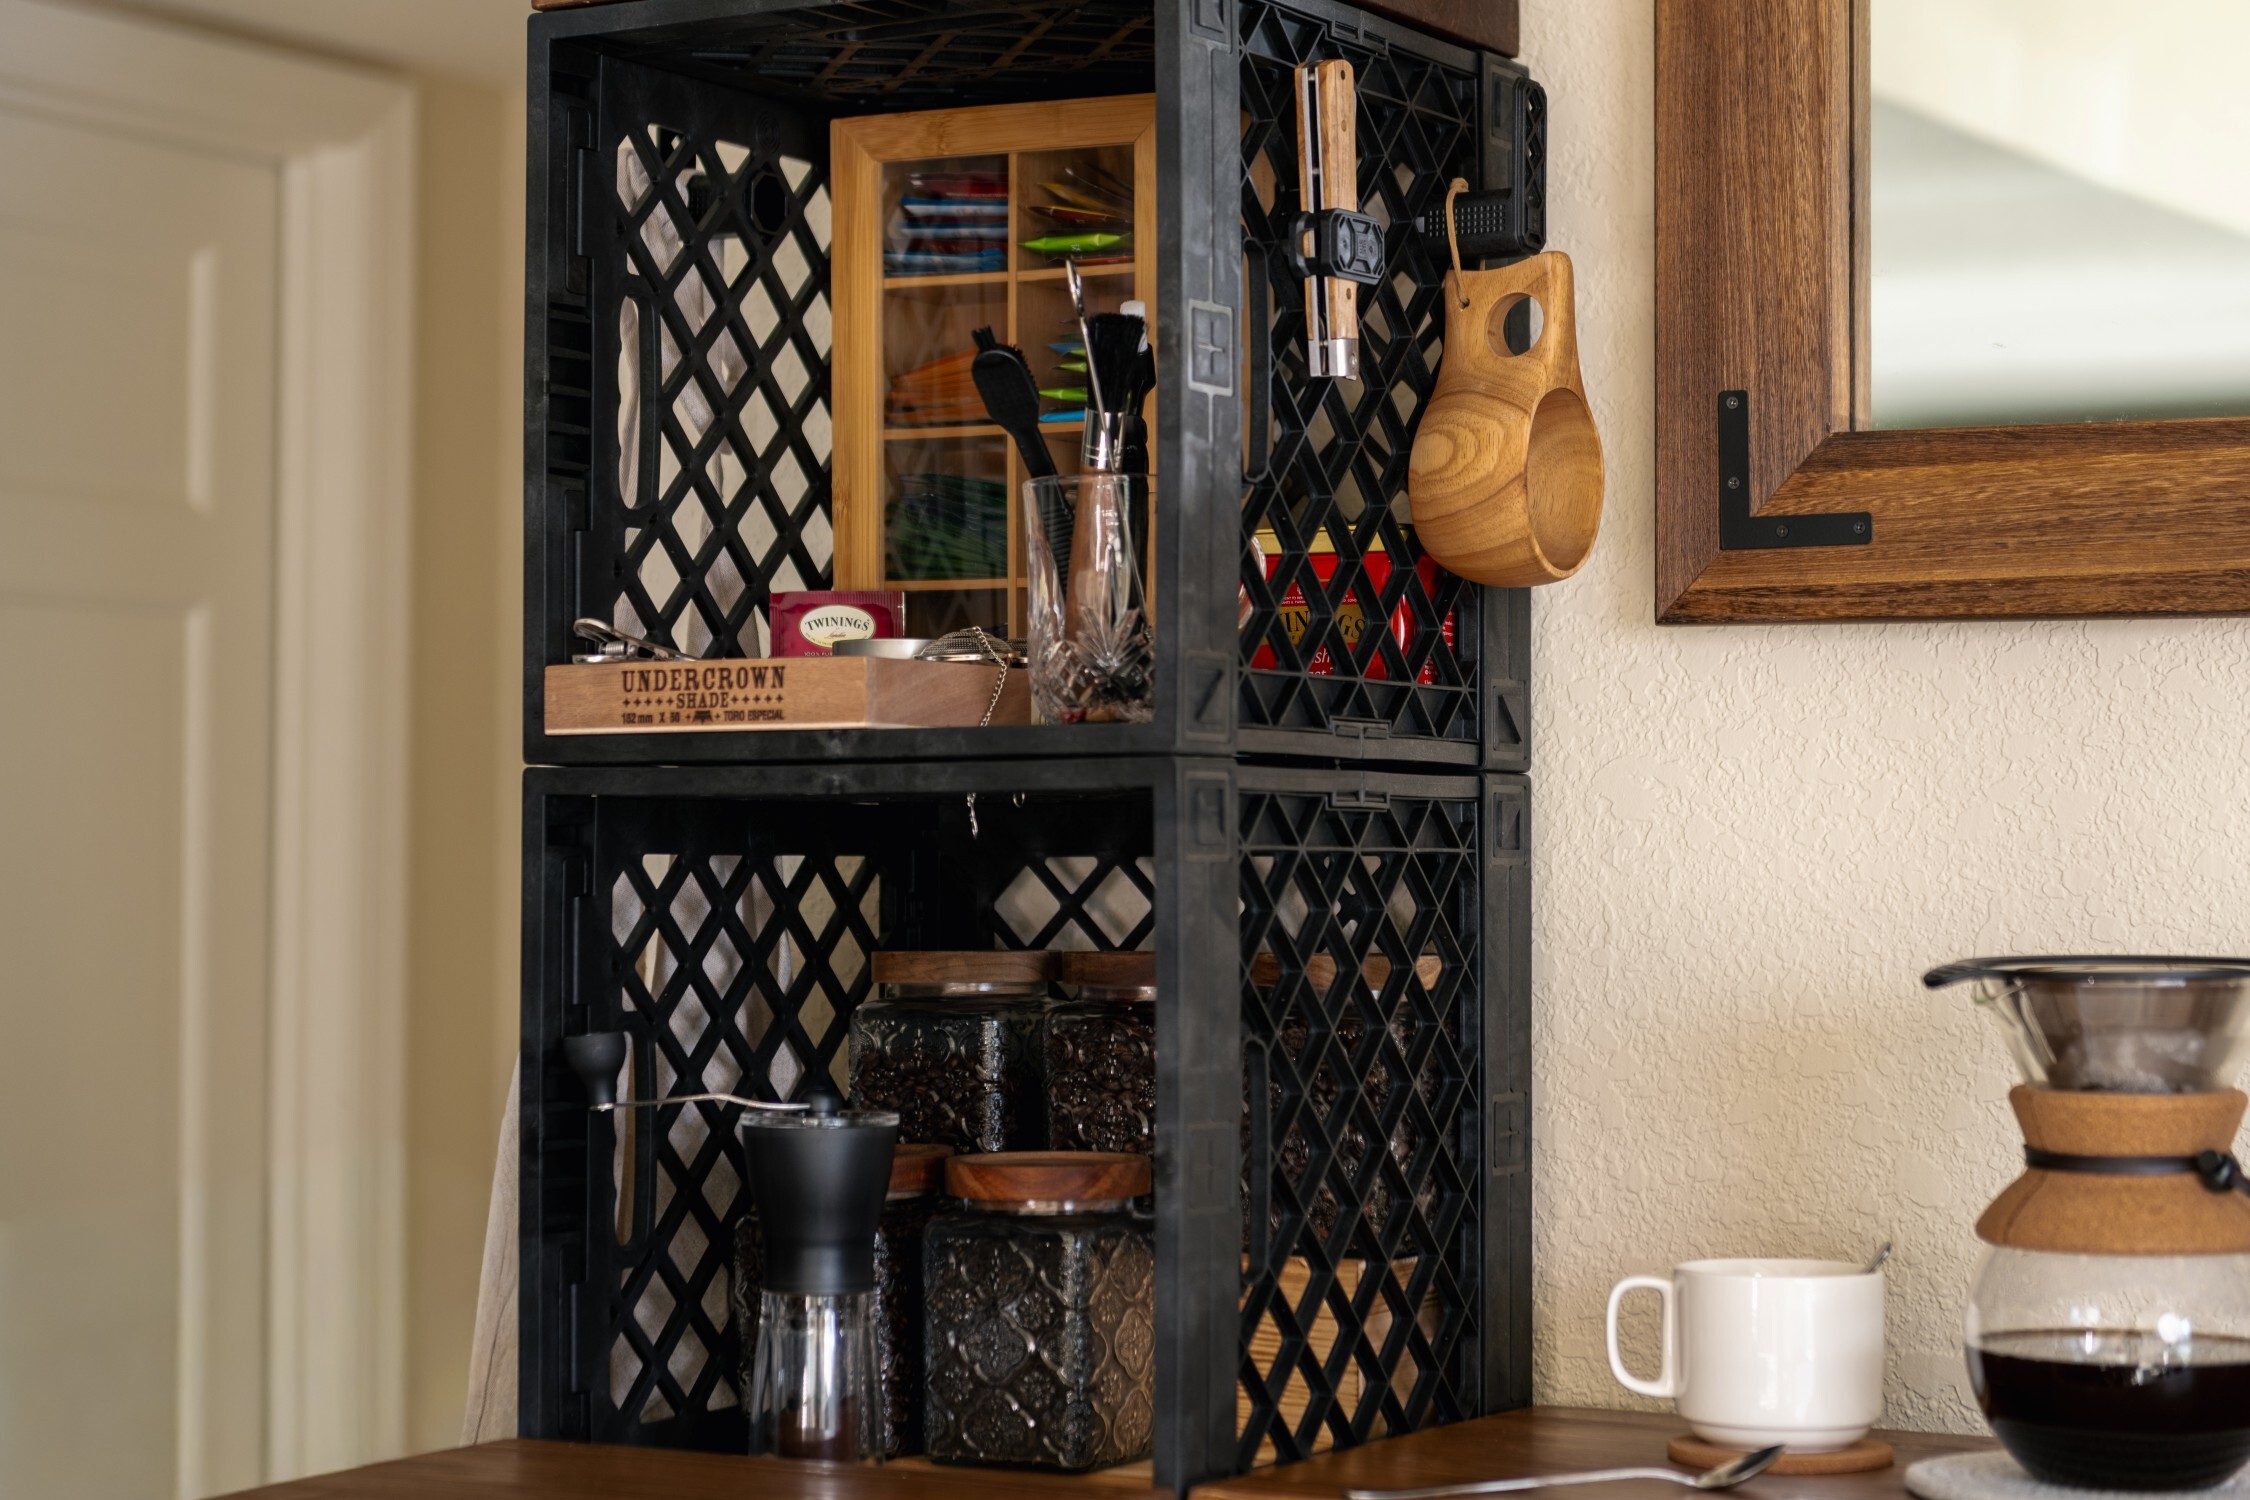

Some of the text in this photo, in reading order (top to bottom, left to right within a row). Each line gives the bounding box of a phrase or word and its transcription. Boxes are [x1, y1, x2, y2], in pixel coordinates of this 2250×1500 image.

[805, 617, 869, 631] TWININGS
[621, 665, 786, 693] UNDERCROWN
[676, 693, 729, 709] SHADE
[670, 711, 681, 723] 50
[723, 710, 744, 722] TORO
[747, 709, 785, 722] ESPECIAL
